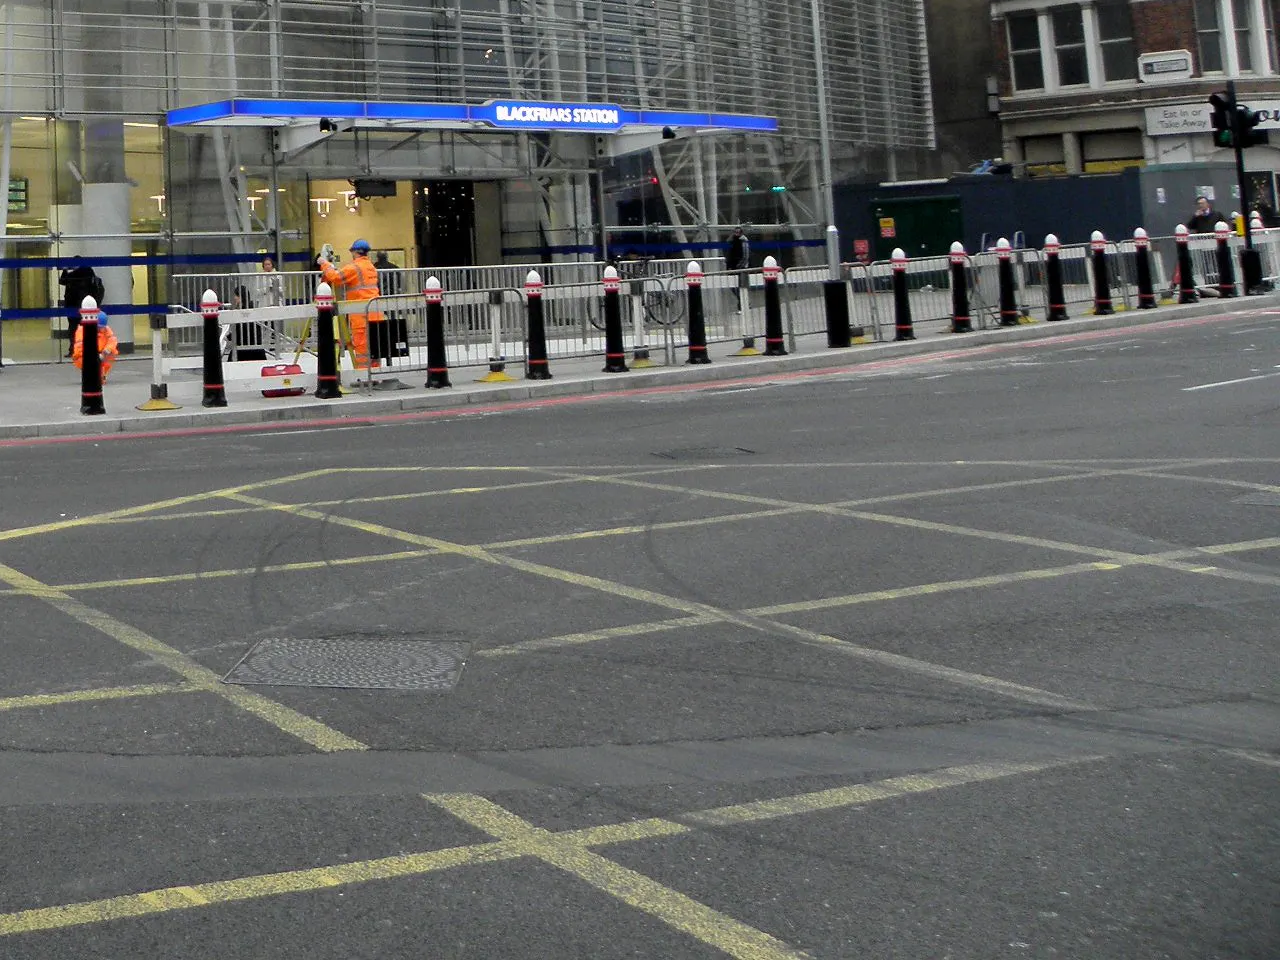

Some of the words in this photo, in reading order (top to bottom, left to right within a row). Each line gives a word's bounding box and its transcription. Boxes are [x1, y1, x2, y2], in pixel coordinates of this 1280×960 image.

[496, 105, 572, 122] BLACKFRIARS
[573, 109, 618, 124] STATION
[1163, 110, 1177, 119] Eat
[1159, 119, 1180, 129] Take
[1182, 118, 1206, 128] Away
